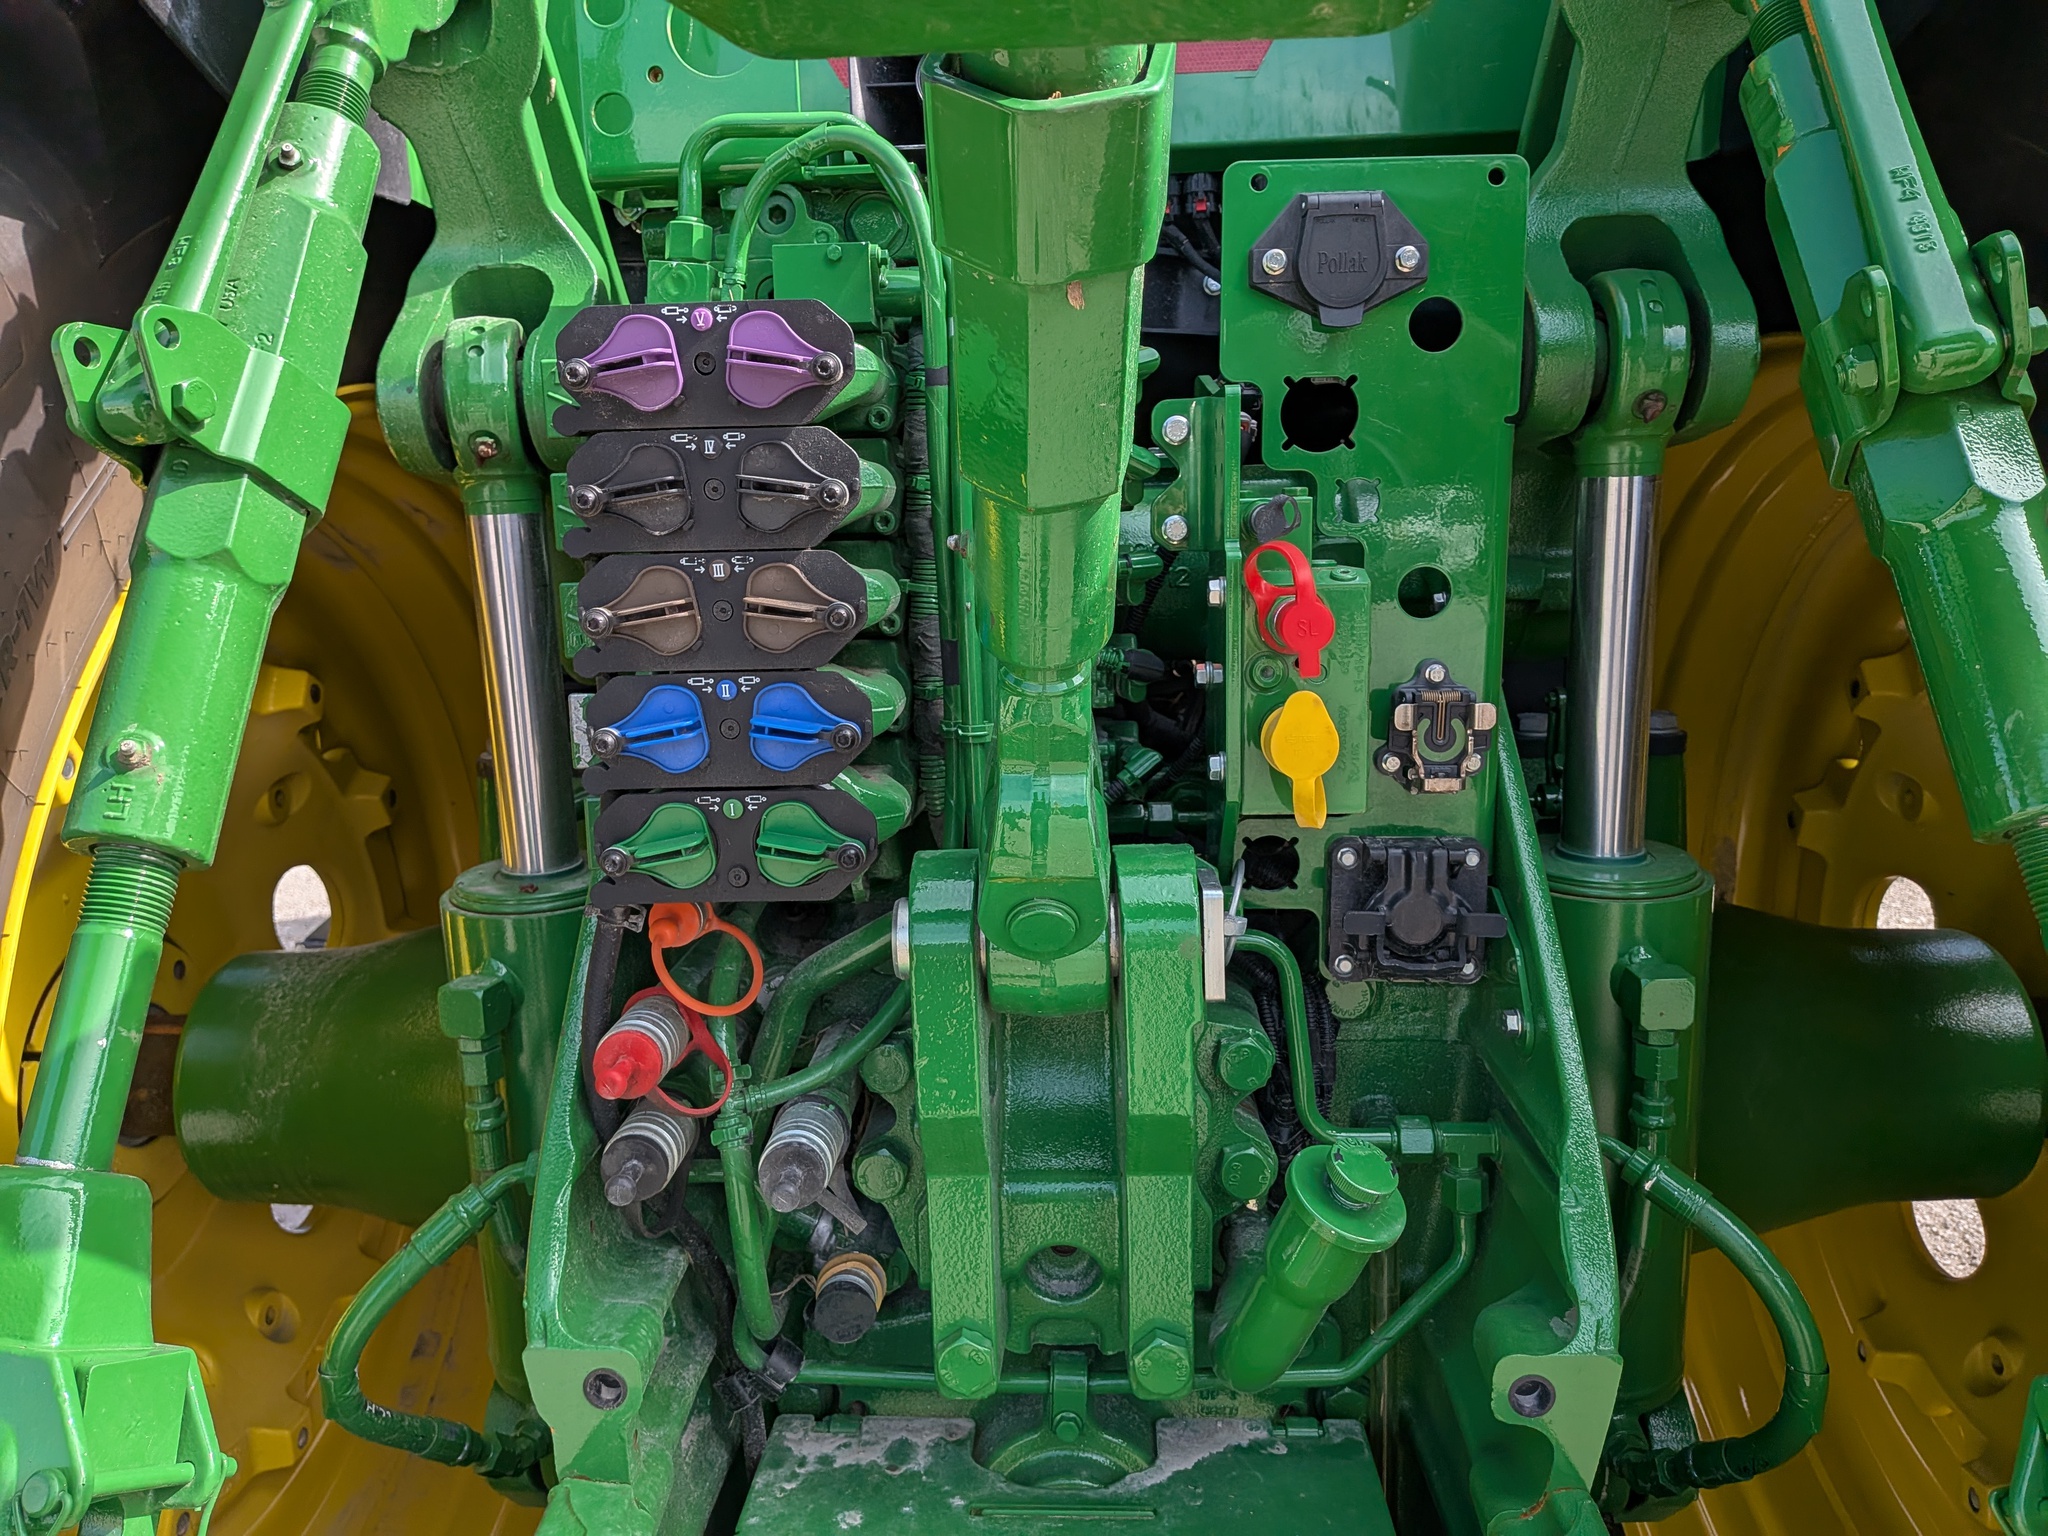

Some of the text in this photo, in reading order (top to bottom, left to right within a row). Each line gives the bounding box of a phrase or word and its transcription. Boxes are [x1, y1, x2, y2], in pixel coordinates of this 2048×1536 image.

[1317, 250, 1368, 274] Pollak
[219, 277, 241, 311] USA
[694, 311, 706, 327] V
[704, 439, 717, 454] IV
[712, 563, 726, 578] III
[1297, 619, 1320, 637] SL
[721, 683, 731, 698] II
[102, 782, 136, 821] LH
